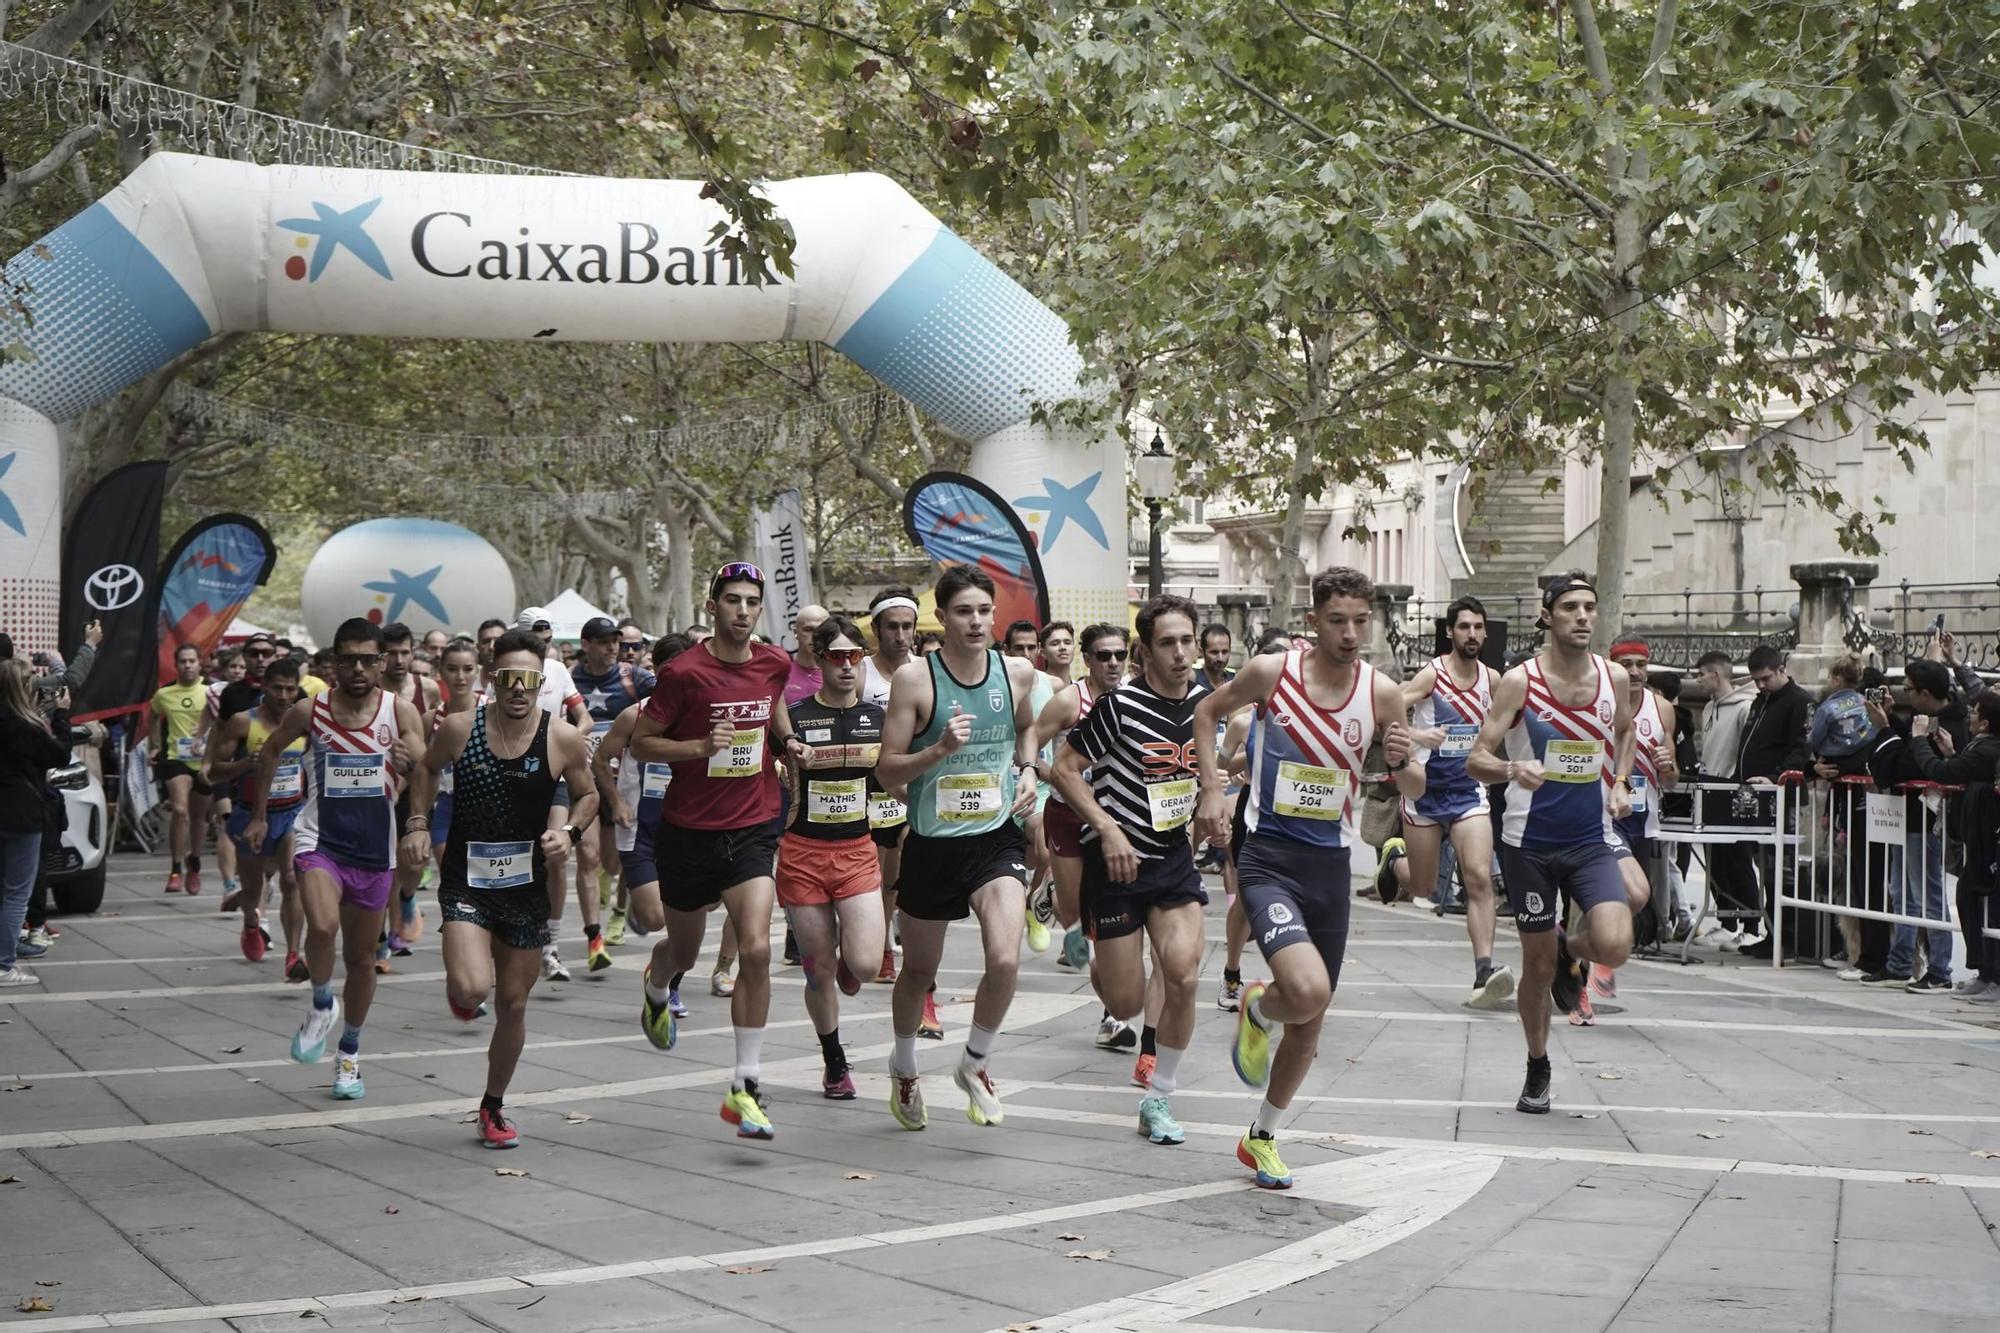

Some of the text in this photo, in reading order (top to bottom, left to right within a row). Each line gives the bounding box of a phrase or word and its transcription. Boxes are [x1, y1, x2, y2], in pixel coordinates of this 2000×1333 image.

[411, 211, 782, 286] CaixaBan
[732, 747, 752, 755] BRU
[732, 757, 750, 766] 502
[1559, 754, 1594, 764] OSCAR
[333, 768, 378, 777] GUILLEM
[1566, 765, 1583, 773] 501
[1292, 782, 1334, 796] YASSIN
[820, 793, 856, 804] MATHIS
[960, 791, 981, 800] JAN
[878, 800, 902, 810] ALEX
[960, 801, 979, 811] 539
[1299, 796, 1322, 807] 504
[829, 805, 847, 813] 603
[882, 810, 899, 819] 503
[490, 857, 512, 867] PAU
[498, 868, 505, 878] 3
